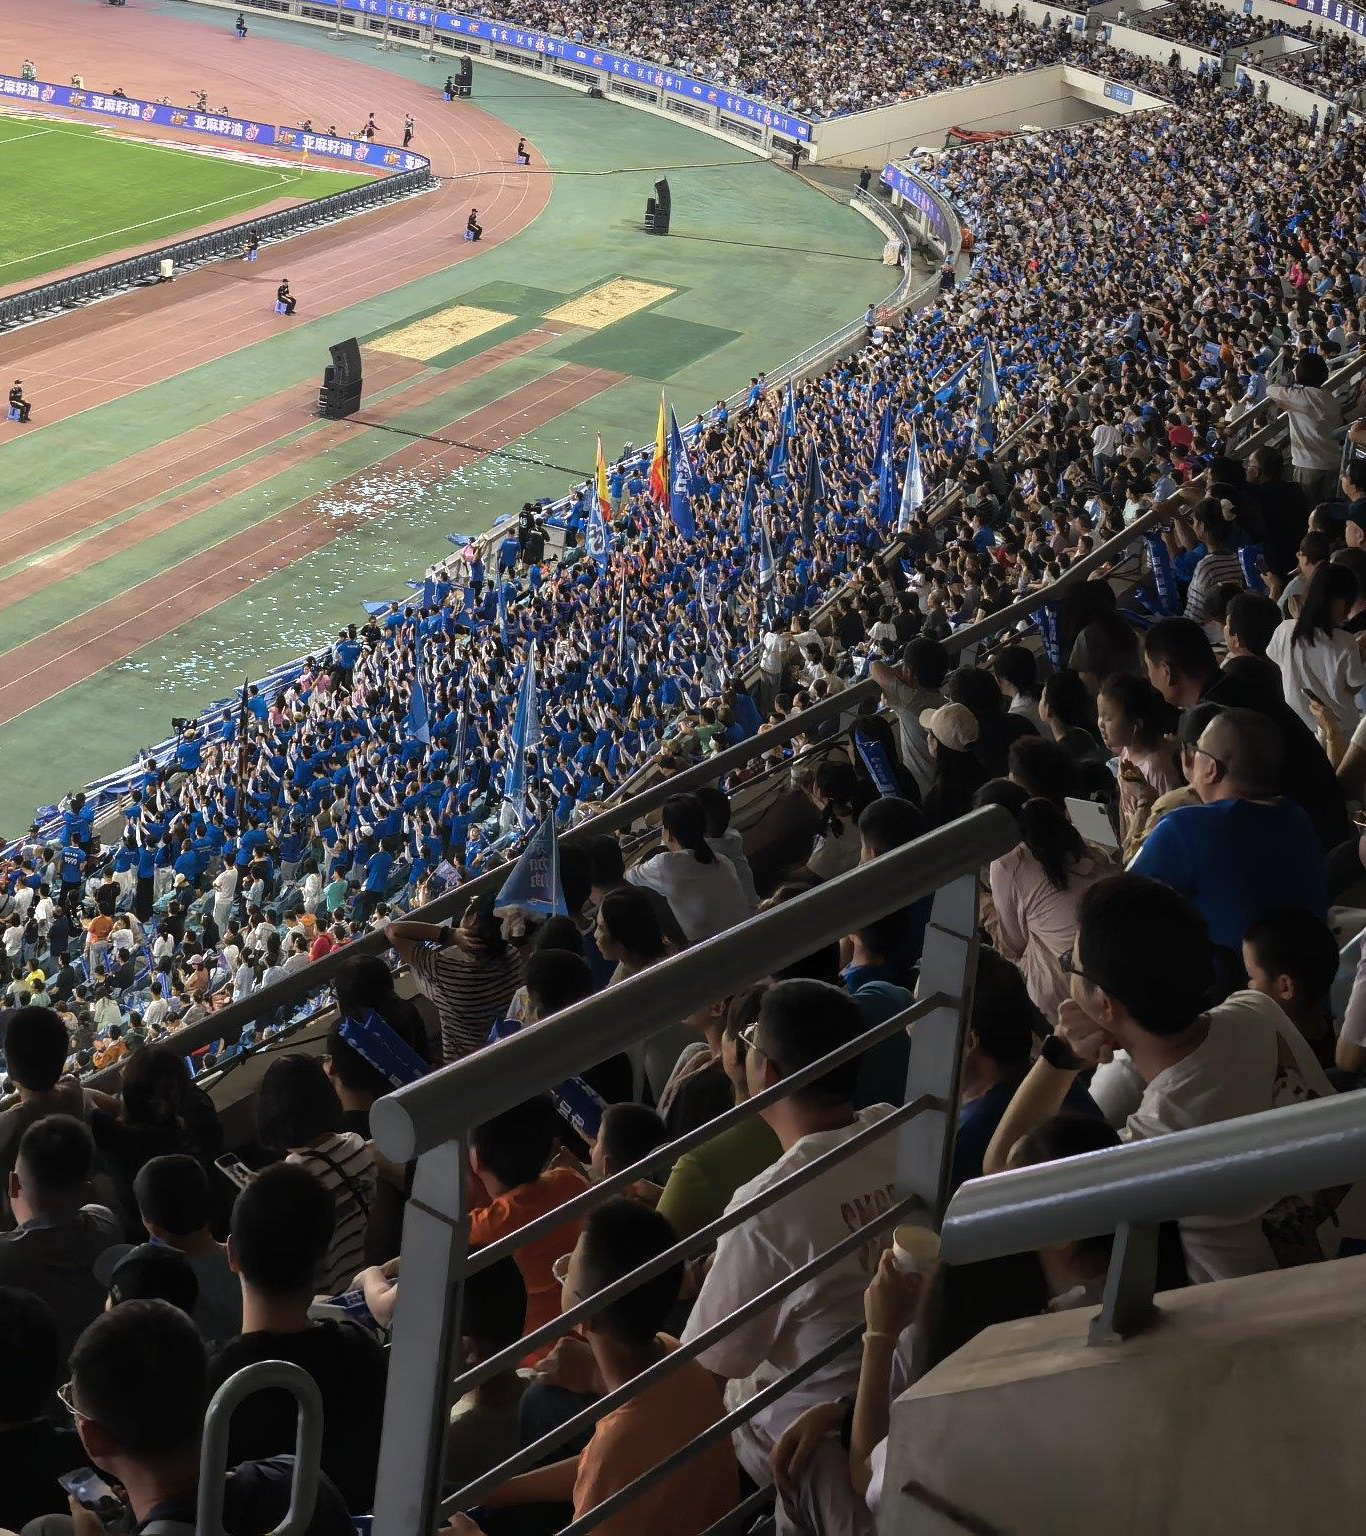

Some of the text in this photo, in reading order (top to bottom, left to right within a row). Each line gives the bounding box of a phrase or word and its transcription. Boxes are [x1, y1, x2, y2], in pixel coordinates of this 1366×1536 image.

[91, 96, 140, 118] 亚麻籽油
[192, 115, 243, 138] 亚麻籽油
[301, 135, 352, 158] 亚麻籽油
